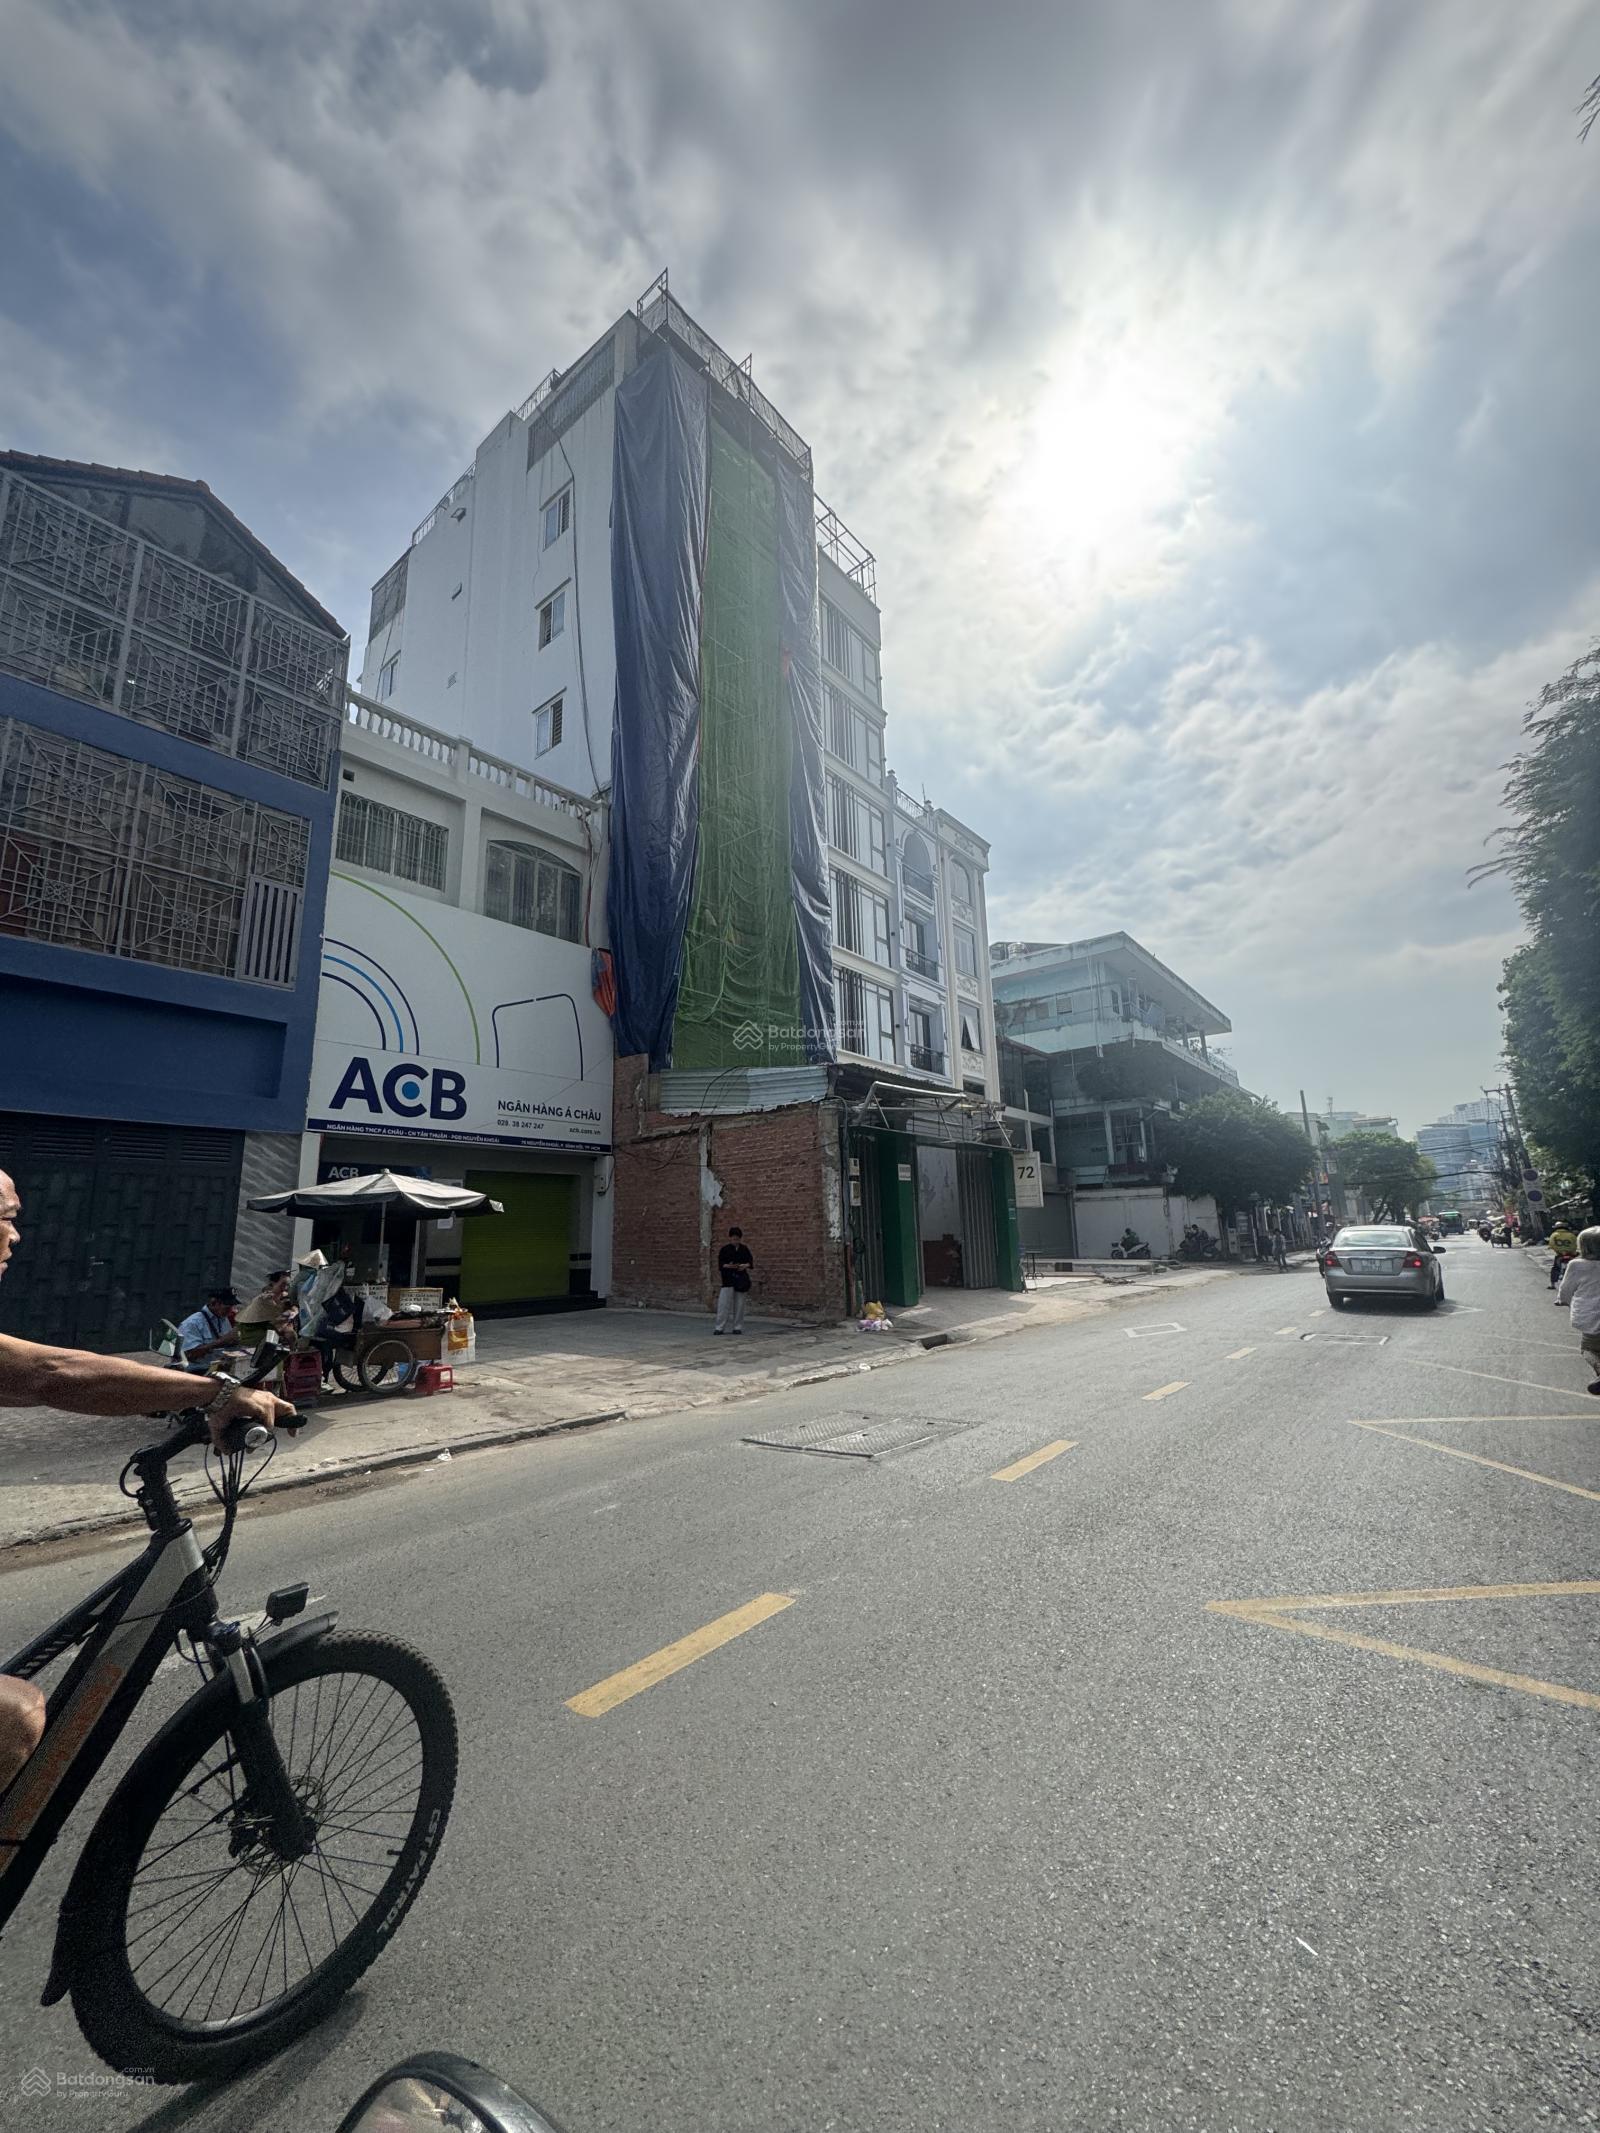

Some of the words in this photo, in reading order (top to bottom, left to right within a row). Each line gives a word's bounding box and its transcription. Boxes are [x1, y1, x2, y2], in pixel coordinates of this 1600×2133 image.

[329, 1056, 467, 1121] ACB
[497, 1099, 531, 1114] NGÂN
[533, 1103, 563, 1117] HÀNG
[565, 1105, 572, 1118] Á
[574, 1108, 602, 1121] CHÂU
[326, 1123, 346, 1131] NGÂN
[346, 1124, 364, 1132] HÀNG
[387, 1128, 404, 1136] CHÂU
[521, 1121, 532, 1129] 247
[327, 1166, 359, 1179] ACB
[1017, 1166, 1035, 1179] 72
[1553, 1237, 1572, 1249] be
